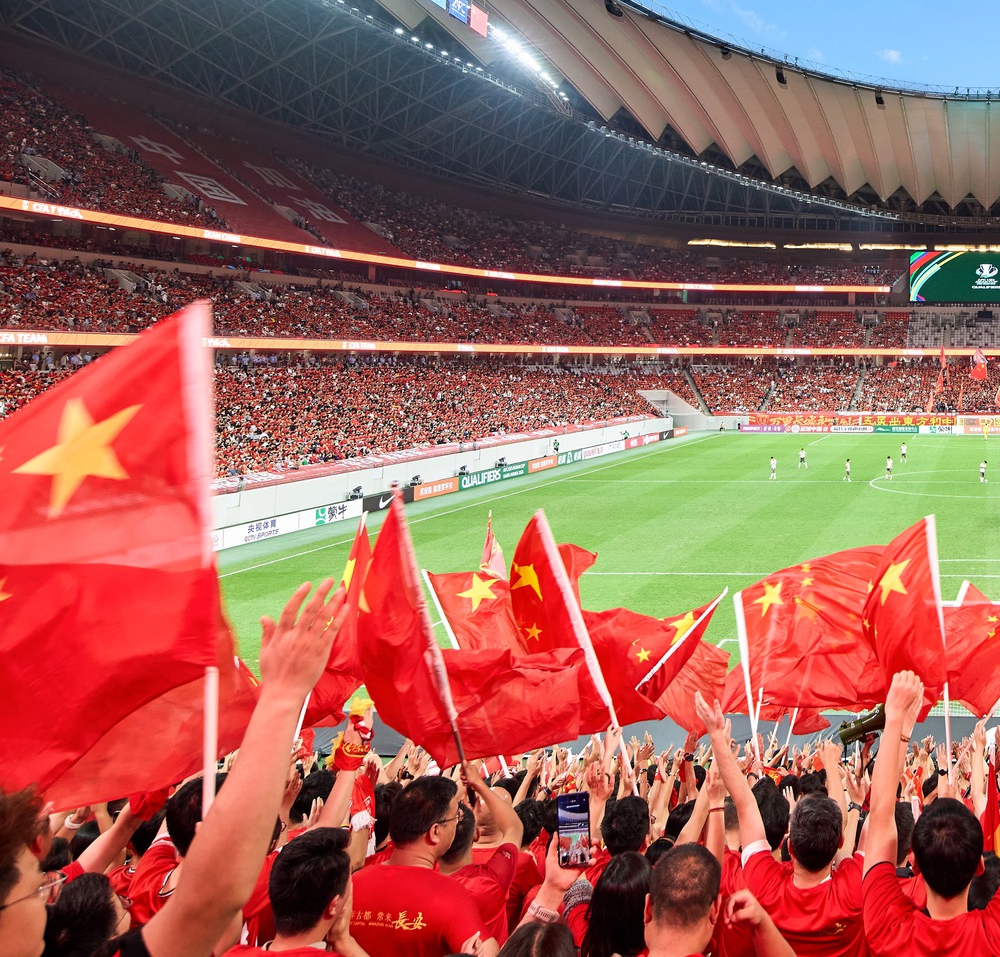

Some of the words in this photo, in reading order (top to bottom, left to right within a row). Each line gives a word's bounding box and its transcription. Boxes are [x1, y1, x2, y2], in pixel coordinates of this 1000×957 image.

[17, 333, 48, 343] TEAM
[462, 469, 501, 489] QUALIFIERS
[328, 504, 347, 521] 蒙牛
[248, 519, 276, 533] 央视体育
[257, 529, 279, 539] SPORTS
